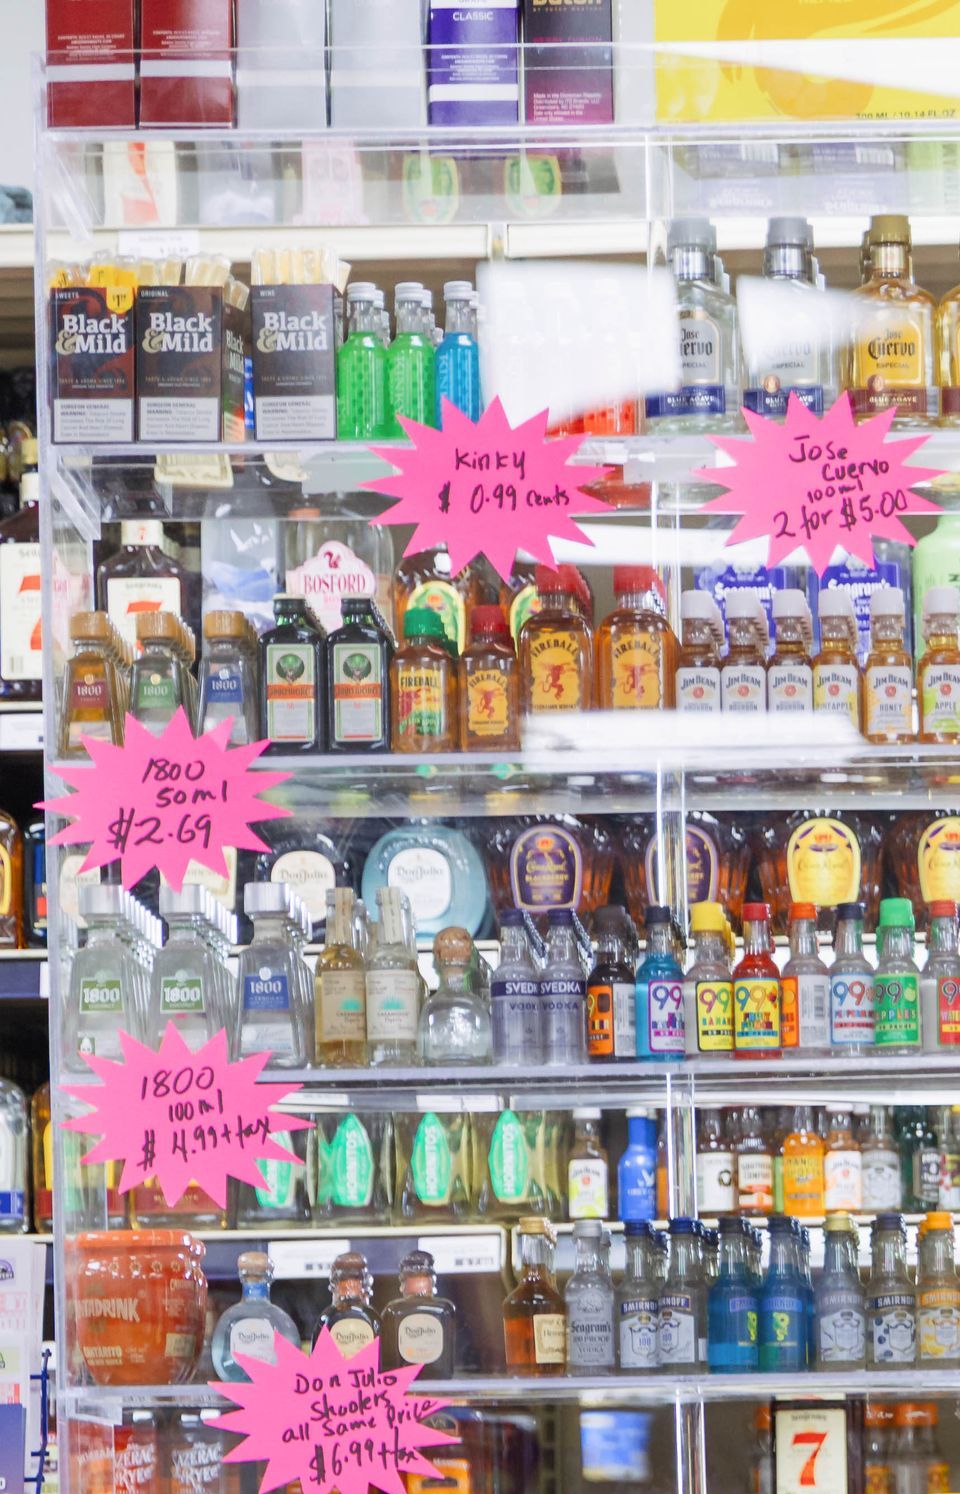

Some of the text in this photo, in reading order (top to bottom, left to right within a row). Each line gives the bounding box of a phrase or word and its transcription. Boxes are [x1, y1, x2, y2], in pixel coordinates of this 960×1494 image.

[452, 11, 494, 22] CLASSIC
[63, 313, 127, 334] Black
[150, 312, 213, 333] Black
[264, 311, 327, 332] Black
[867, 338, 916, 360] Cuervo
[437, 481, 450, 514] $
[470, 483, 517, 514] 0.99
[773, 510, 797, 538] 2
[799, 504, 834, 540] for
[303, 573, 367, 593] BOSFORD
[141, 757, 206, 784] 1800
[106, 807, 214, 855] $2.69
[83, 985, 121, 1003] 1800
[163, 985, 200, 1003] 1800
[249, 979, 283, 994] 1800
[540, 981, 582, 995] SVEDKA
[652, 984, 684, 1011] 99
[735, 985, 768, 1009] 99
[832, 980, 866, 1007] 99
[873, 980, 901, 1002] 99
[699, 987, 732, 1013] 99
[140, 1066, 216, 1100] 1800
[136, 1128, 156, 1171] $
[293, 1372, 341, 1396] Don
[790, 1430, 830, 1487] 7
